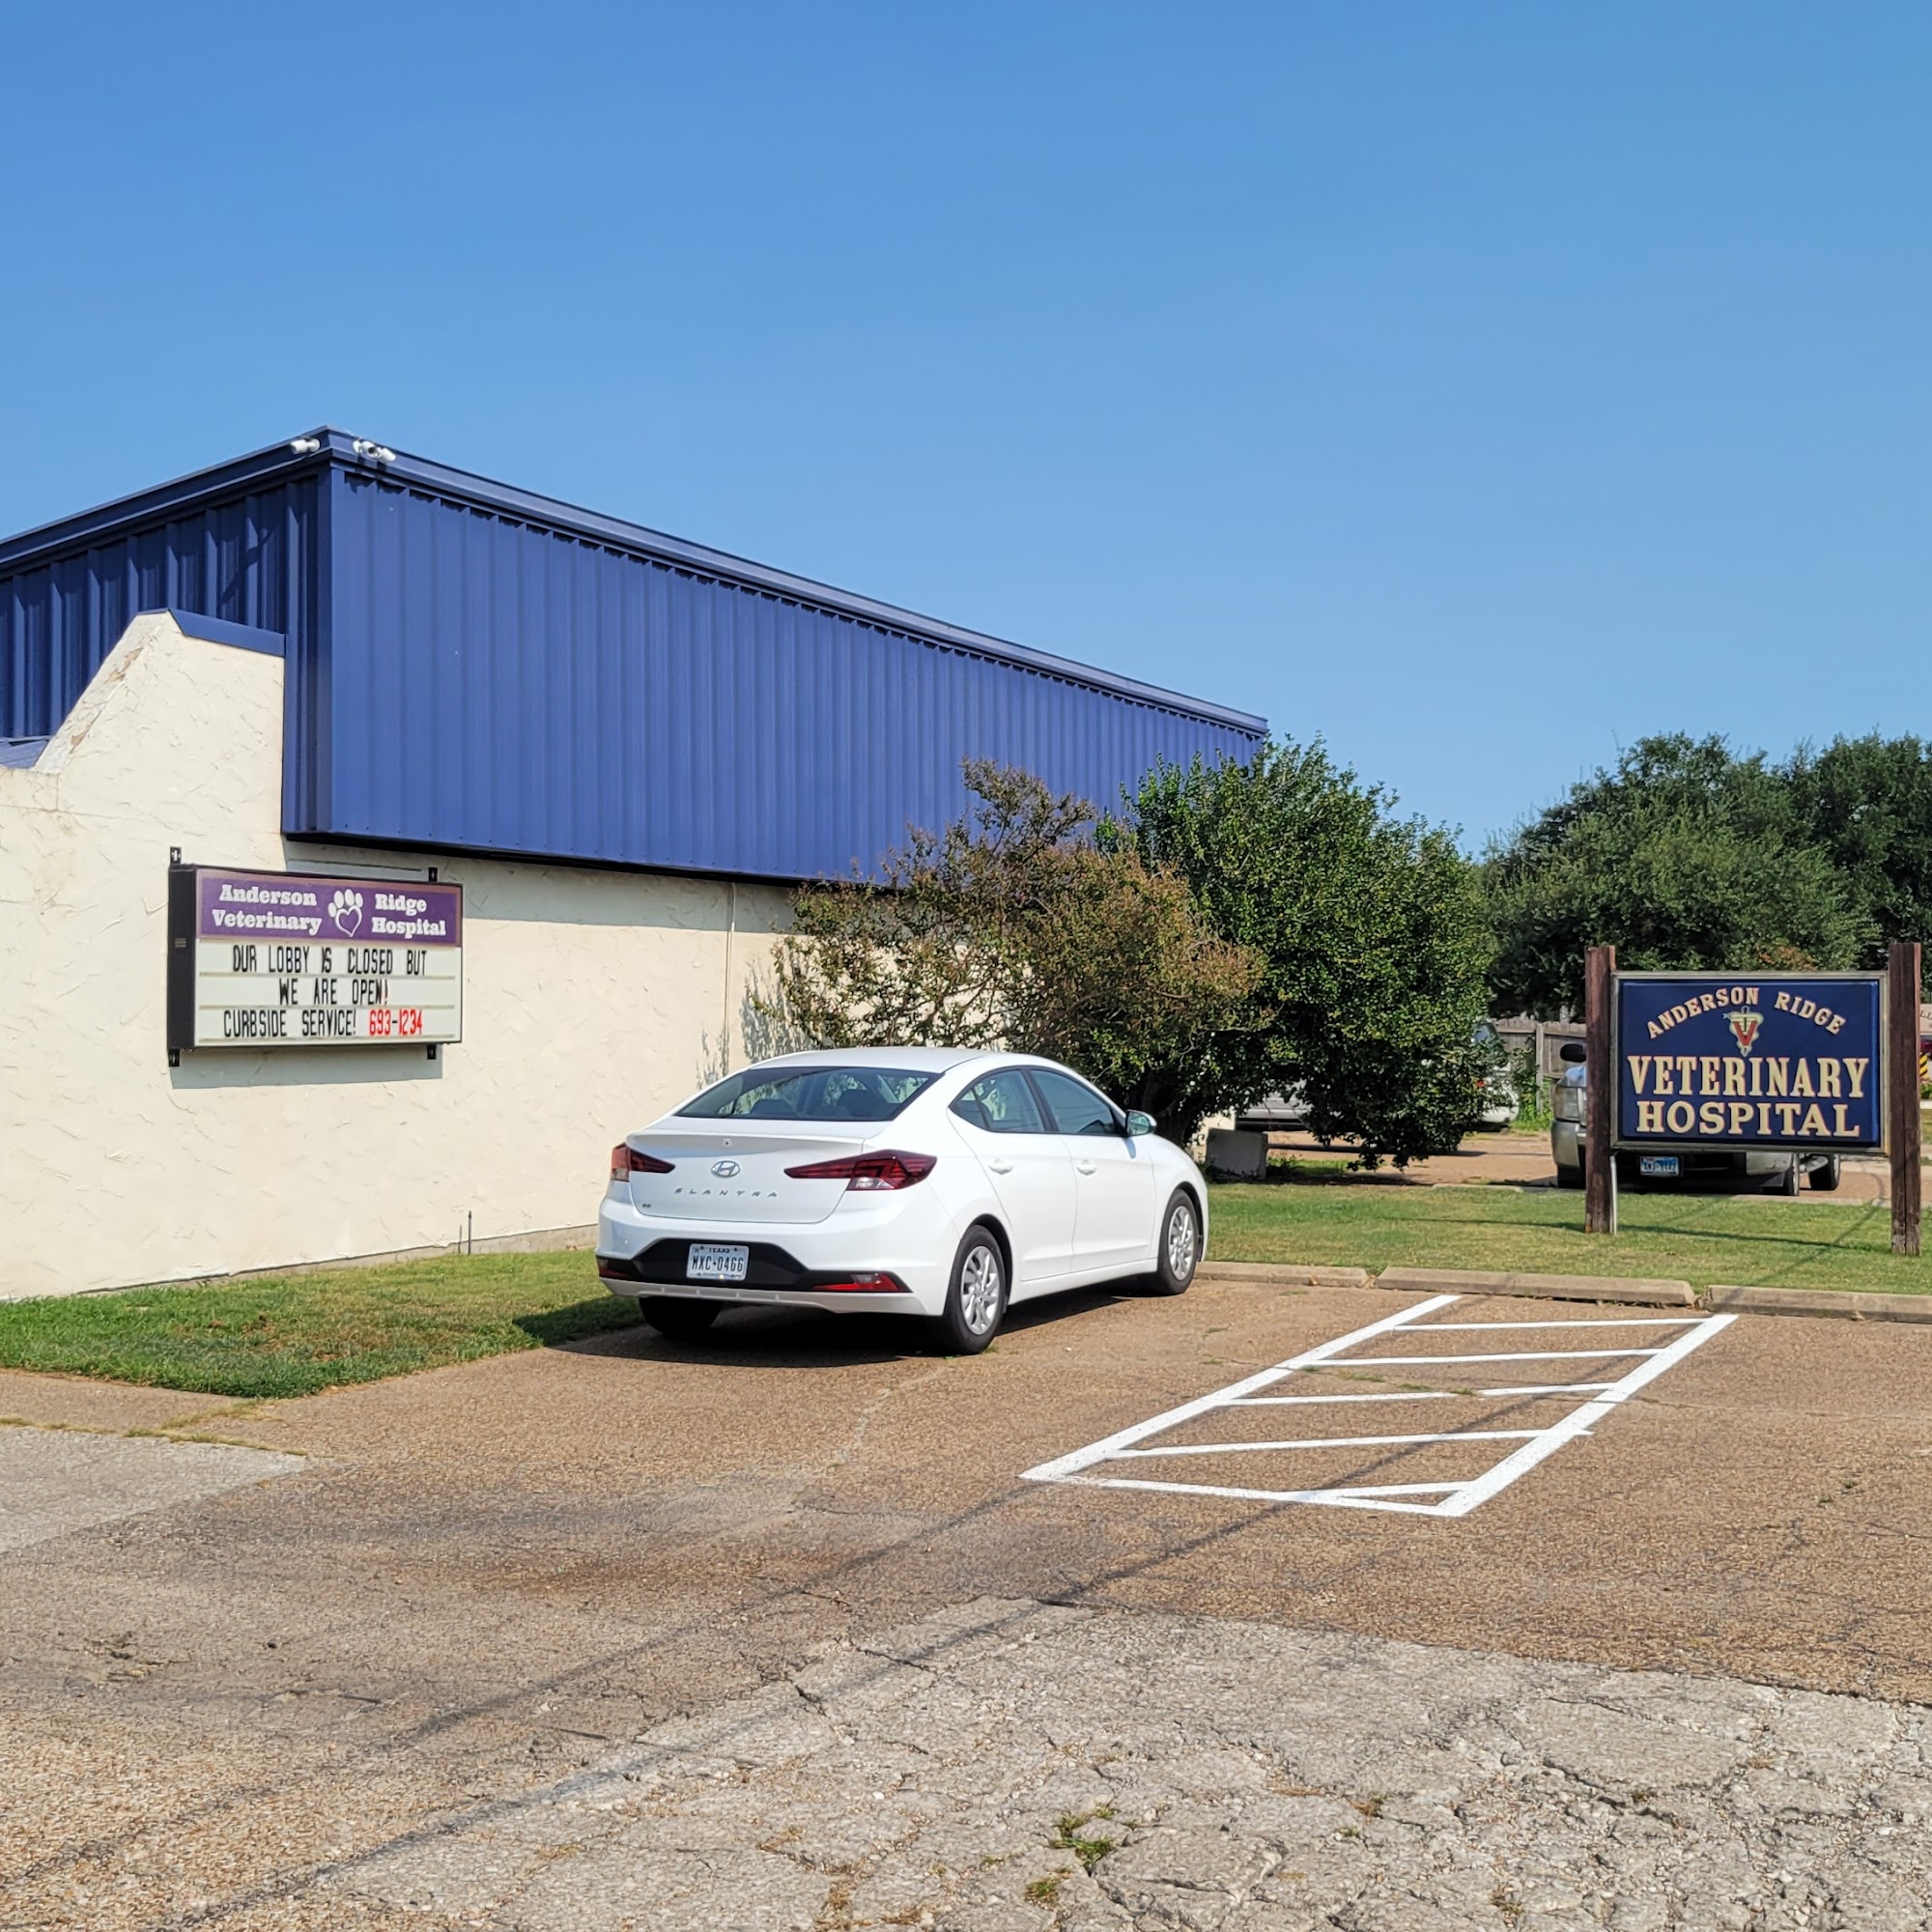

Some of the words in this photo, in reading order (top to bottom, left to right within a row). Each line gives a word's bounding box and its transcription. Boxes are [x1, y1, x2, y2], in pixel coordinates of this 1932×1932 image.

[219, 884, 317, 906] Anderson
[375, 894, 427, 916] Ridge
[212, 909, 322, 936] Veterinary
[372, 917, 446, 939] Hospital
[233, 945, 257, 973] OUR
[269, 946, 310, 974] LOBBY
[322, 947, 332, 974] IS
[348, 948, 393, 975] CLOSED
[407, 950, 427, 976] BUT
[279, 978, 298, 1005] WE
[313, 978, 337, 1005] ARE
[352, 979, 389, 1005] OPEN!
[223, 1009, 288, 1037] CURBSIDE
[301, 1009, 356, 1037] SERVICE!
[368, 1009, 423, 1036] 693-1234
[1647, 986, 1760, 1039] ANDERSON
[1774, 991, 1846, 1035] RIDGE
[1627, 1055, 1869, 1098] VETERINARY
[1635, 1100, 1861, 1138] HOSPITAL
[674, 1187, 778, 1198] ELANTRA
